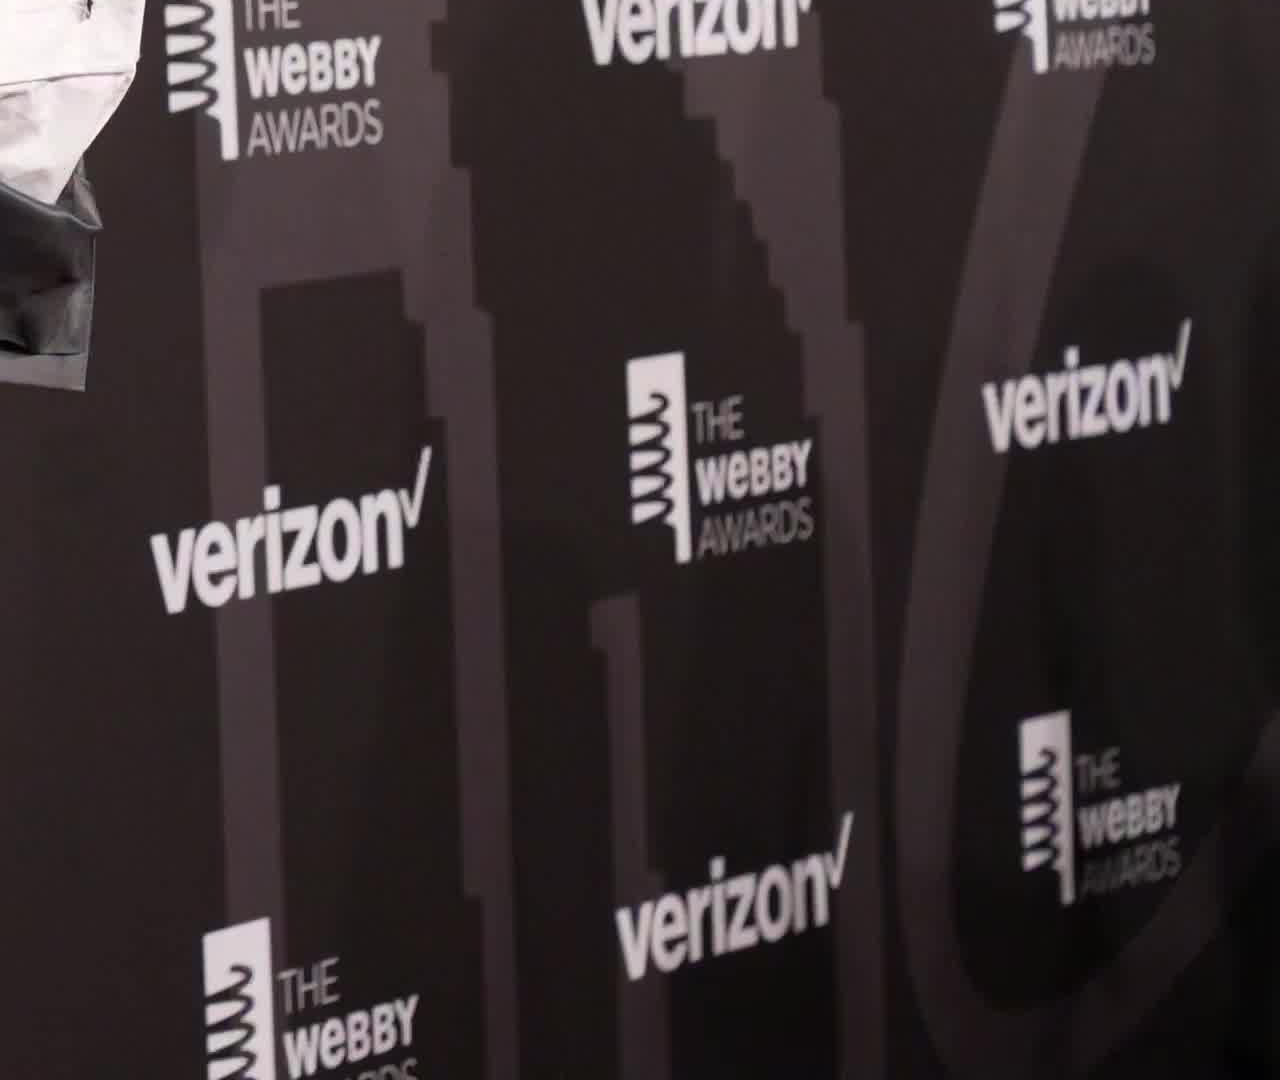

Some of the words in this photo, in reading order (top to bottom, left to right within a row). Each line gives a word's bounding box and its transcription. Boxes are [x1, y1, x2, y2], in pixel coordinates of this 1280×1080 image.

[244, 35, 381, 99] WeBBY
[1053, 24, 1155, 70] AWARDS
[247, 99, 383, 156] AWARDS
[691, 396, 745, 444] THE
[982, 347, 1172, 453] verizon
[695, 440, 812, 505] WeBBY
[150, 484, 404, 614] verizon
[697, 498, 814, 557] AWARDS
[1074, 746, 1121, 792] THE
[1078, 783, 1181, 850] WeBBY
[1081, 834, 1182, 900] AWARDS
[615, 855, 835, 981] verizon
[276, 956, 340, 1014] THE
[283, 994, 419, 1080] WeBBY
